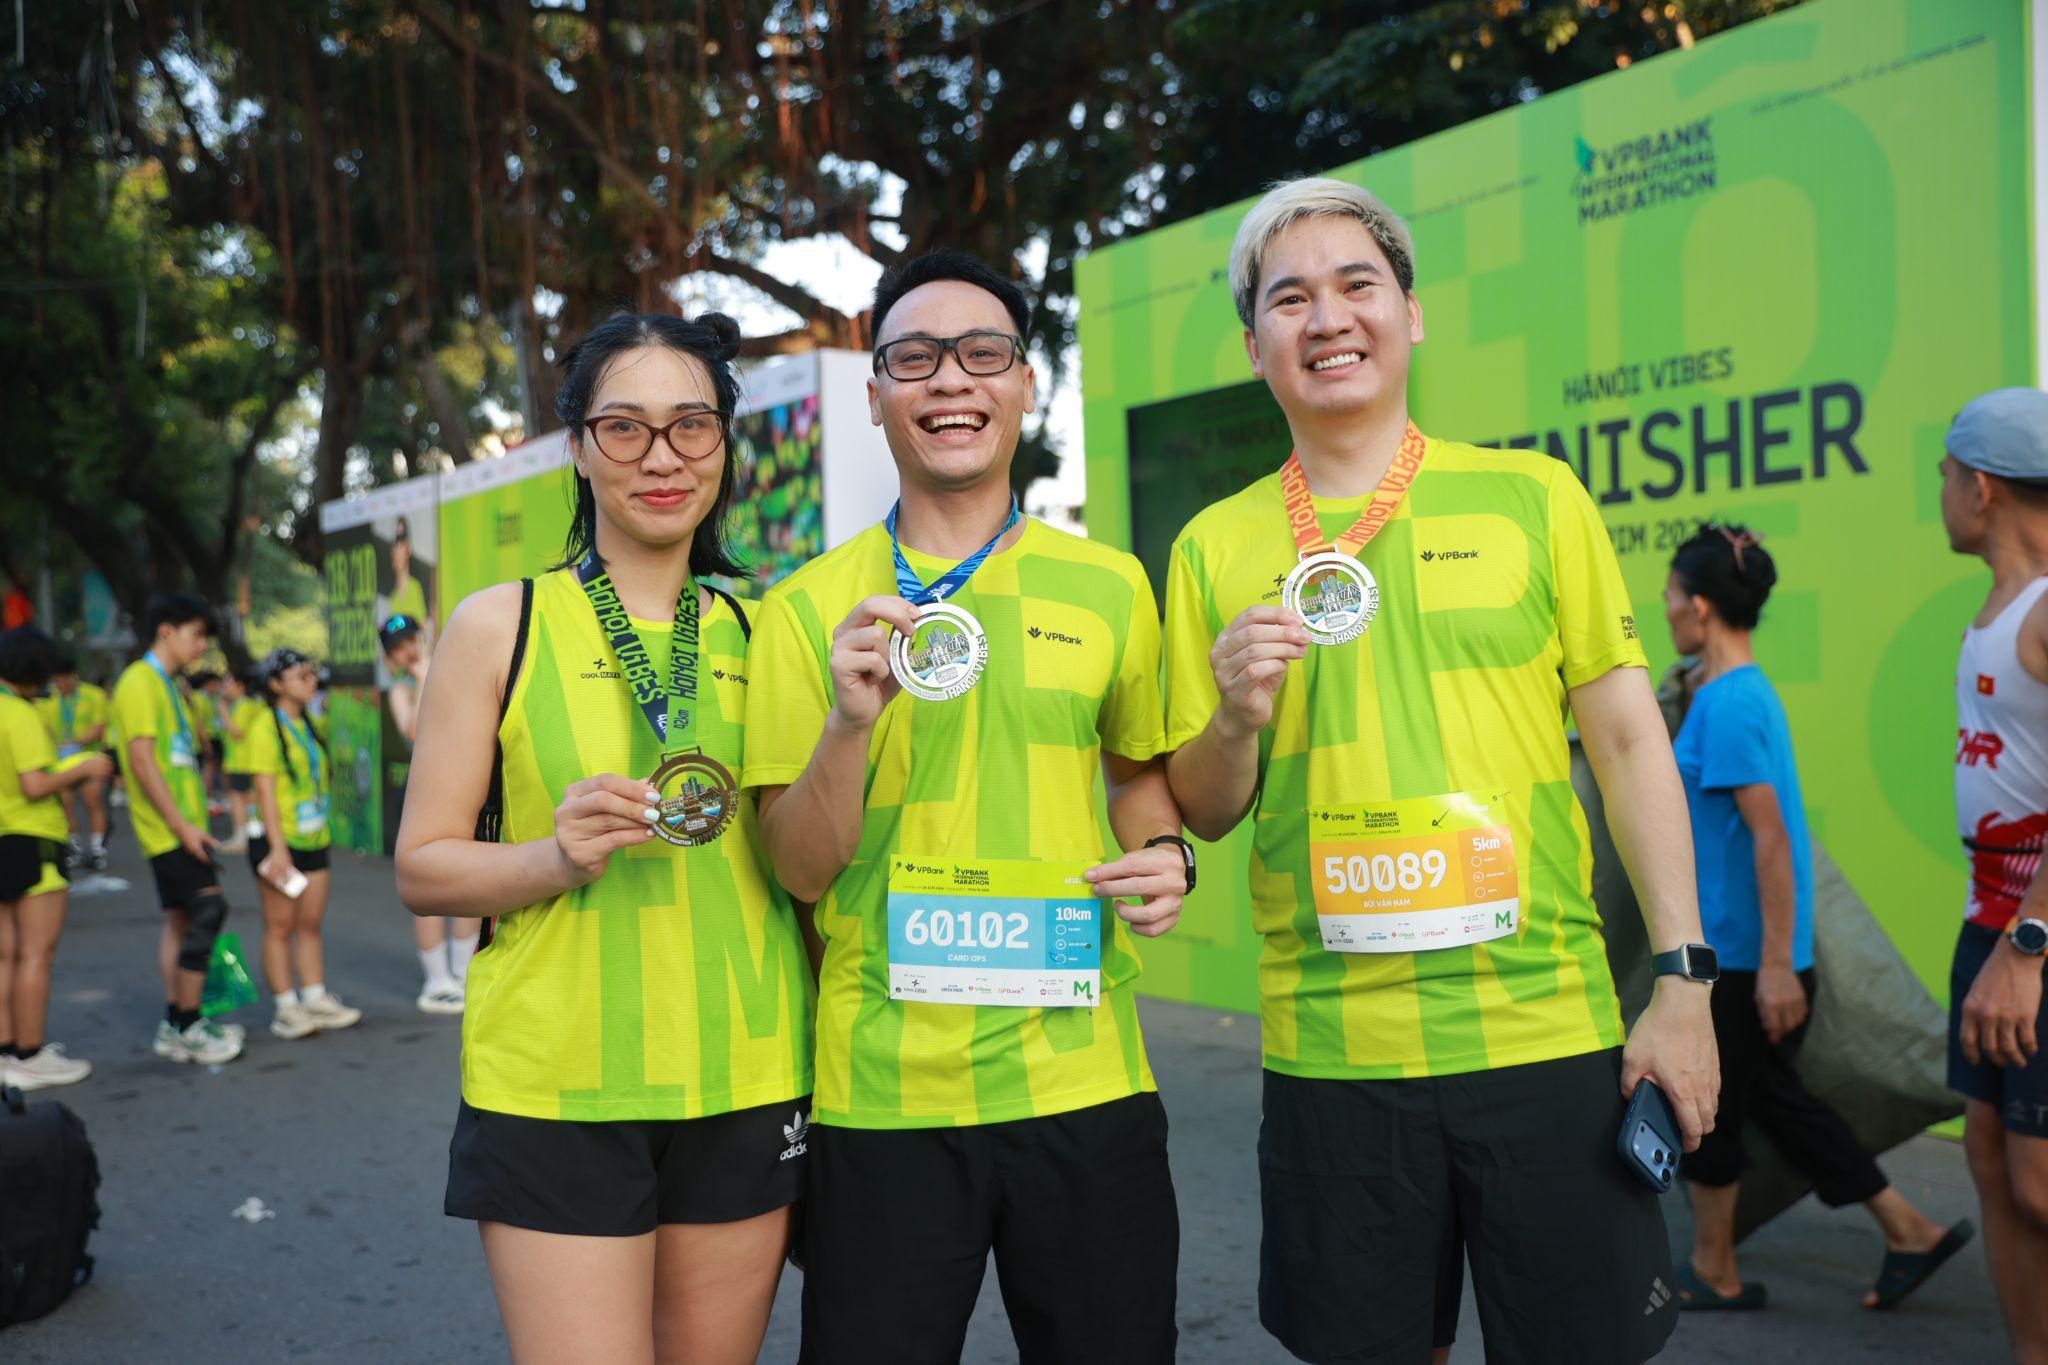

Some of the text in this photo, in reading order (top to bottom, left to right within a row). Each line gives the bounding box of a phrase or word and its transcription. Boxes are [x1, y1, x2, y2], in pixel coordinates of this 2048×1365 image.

[1601, 115, 1714, 171] VPBANK
[1578, 170, 1716, 227] MARATHON
[1651, 347, 1734, 391] VIBES
[1437, 550, 1479, 561] VPBank
[1044, 632, 1082, 646] VPBank
[727, 673, 749, 686] VPBa
[1331, 813, 1356, 821] VPBank
[1370, 811, 1398, 819] VPBANK
[1472, 837, 1501, 852] 5km
[917, 866, 945, 875] VPBank
[961, 869, 989, 877] VPBANK
[1324, 849, 1447, 894] 50089
[1055, 907, 1092, 921] 10km
[905, 909, 1029, 949] 60102
[947, 954, 969, 962] CARD
